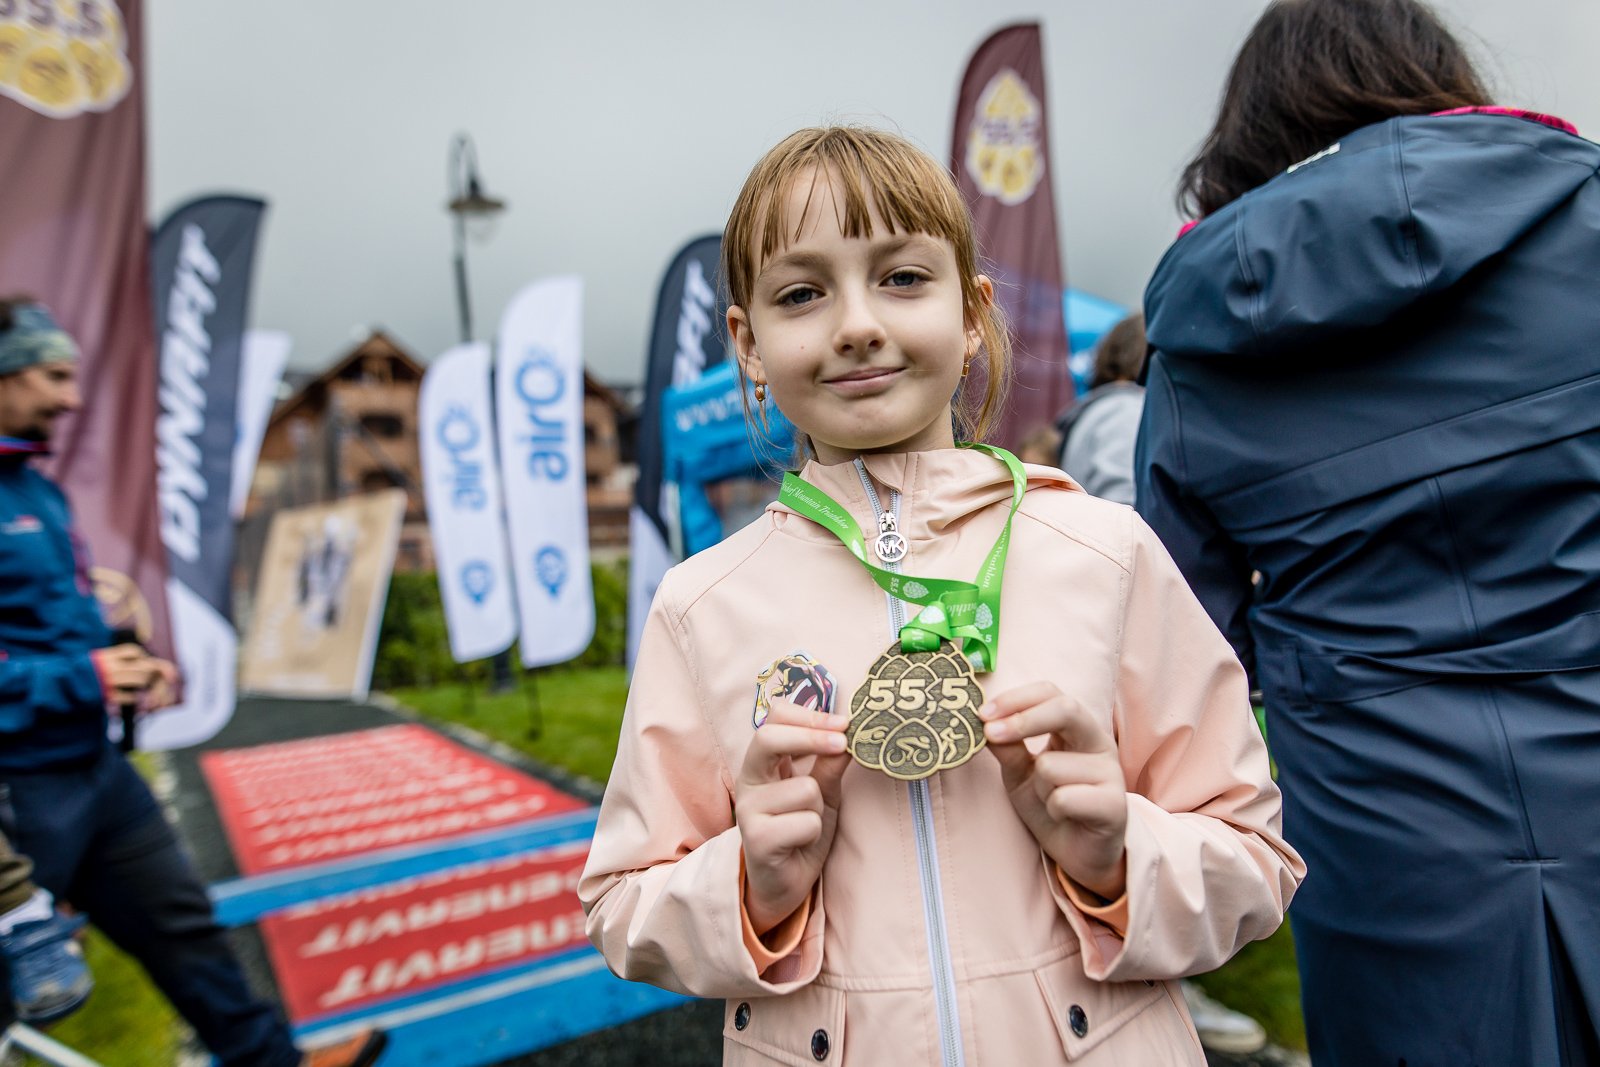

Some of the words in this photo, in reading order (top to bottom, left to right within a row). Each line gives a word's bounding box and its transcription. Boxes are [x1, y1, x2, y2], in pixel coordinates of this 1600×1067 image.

[155, 223, 222, 563] DYNAFIT
[793, 487, 820, 509] Mountain
[865, 677, 970, 715] 55,5
